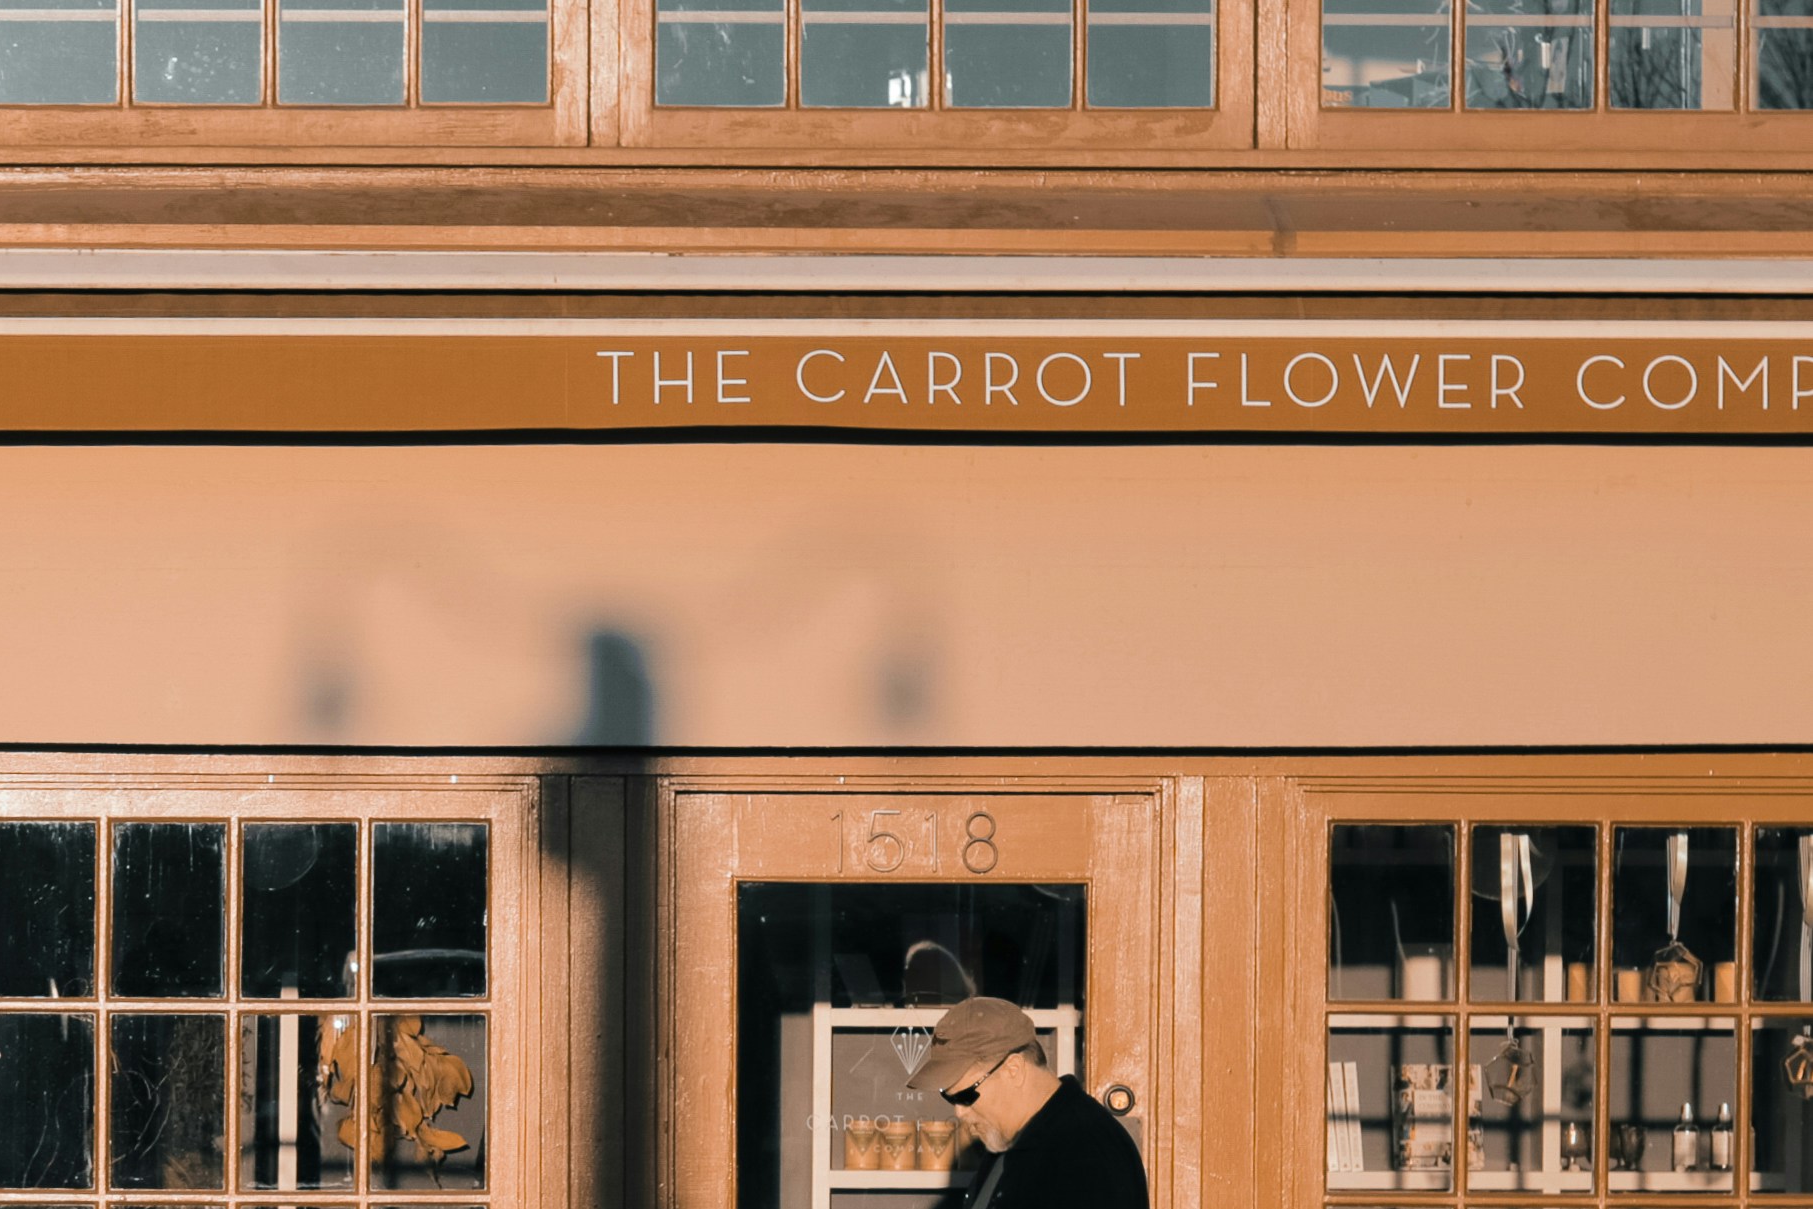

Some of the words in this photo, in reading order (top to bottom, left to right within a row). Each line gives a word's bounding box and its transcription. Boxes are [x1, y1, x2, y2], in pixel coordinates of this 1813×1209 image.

[596, 350, 750, 404] THE
[796, 349, 1140, 406] CARROT
[1187, 352, 1524, 408] FLOWER
[830, 809, 999, 874] 1518
[896, 1092, 924, 1101] THE
[806, 1113, 905, 1132] CARROT
